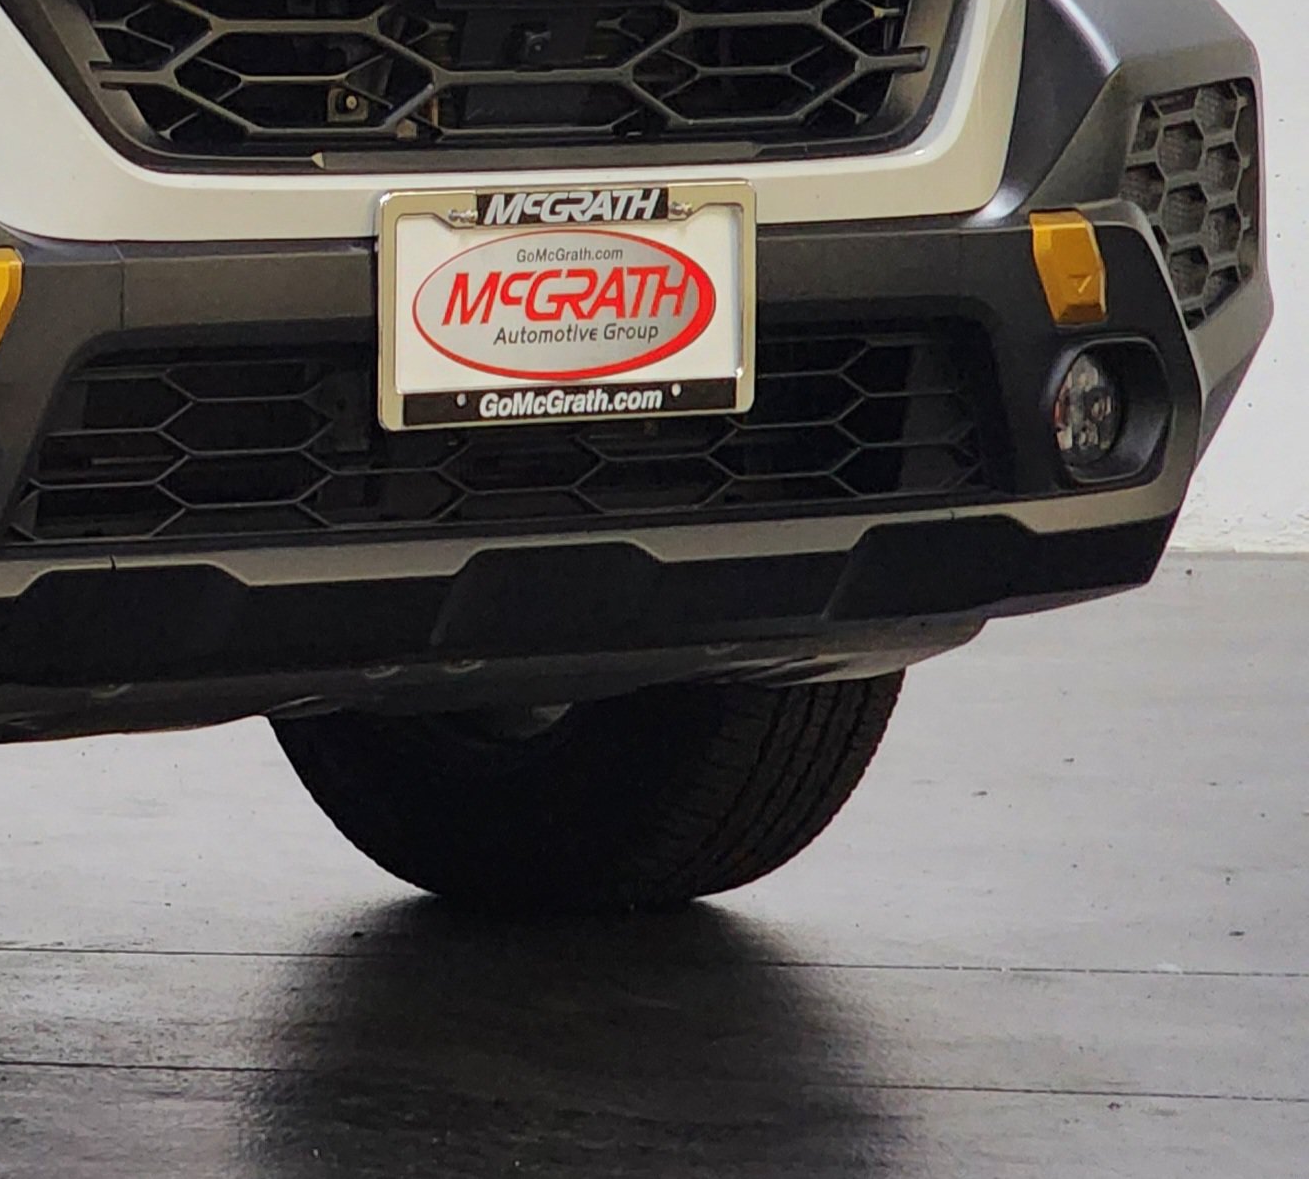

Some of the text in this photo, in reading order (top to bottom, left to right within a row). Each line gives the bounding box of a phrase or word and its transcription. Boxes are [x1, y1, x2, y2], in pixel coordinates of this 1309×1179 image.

[516, 246, 623, 264] GoMcGrath.com
[493, 322, 659, 346] Automotive Group
[479, 386, 663, 418] GoMcGrath.com
